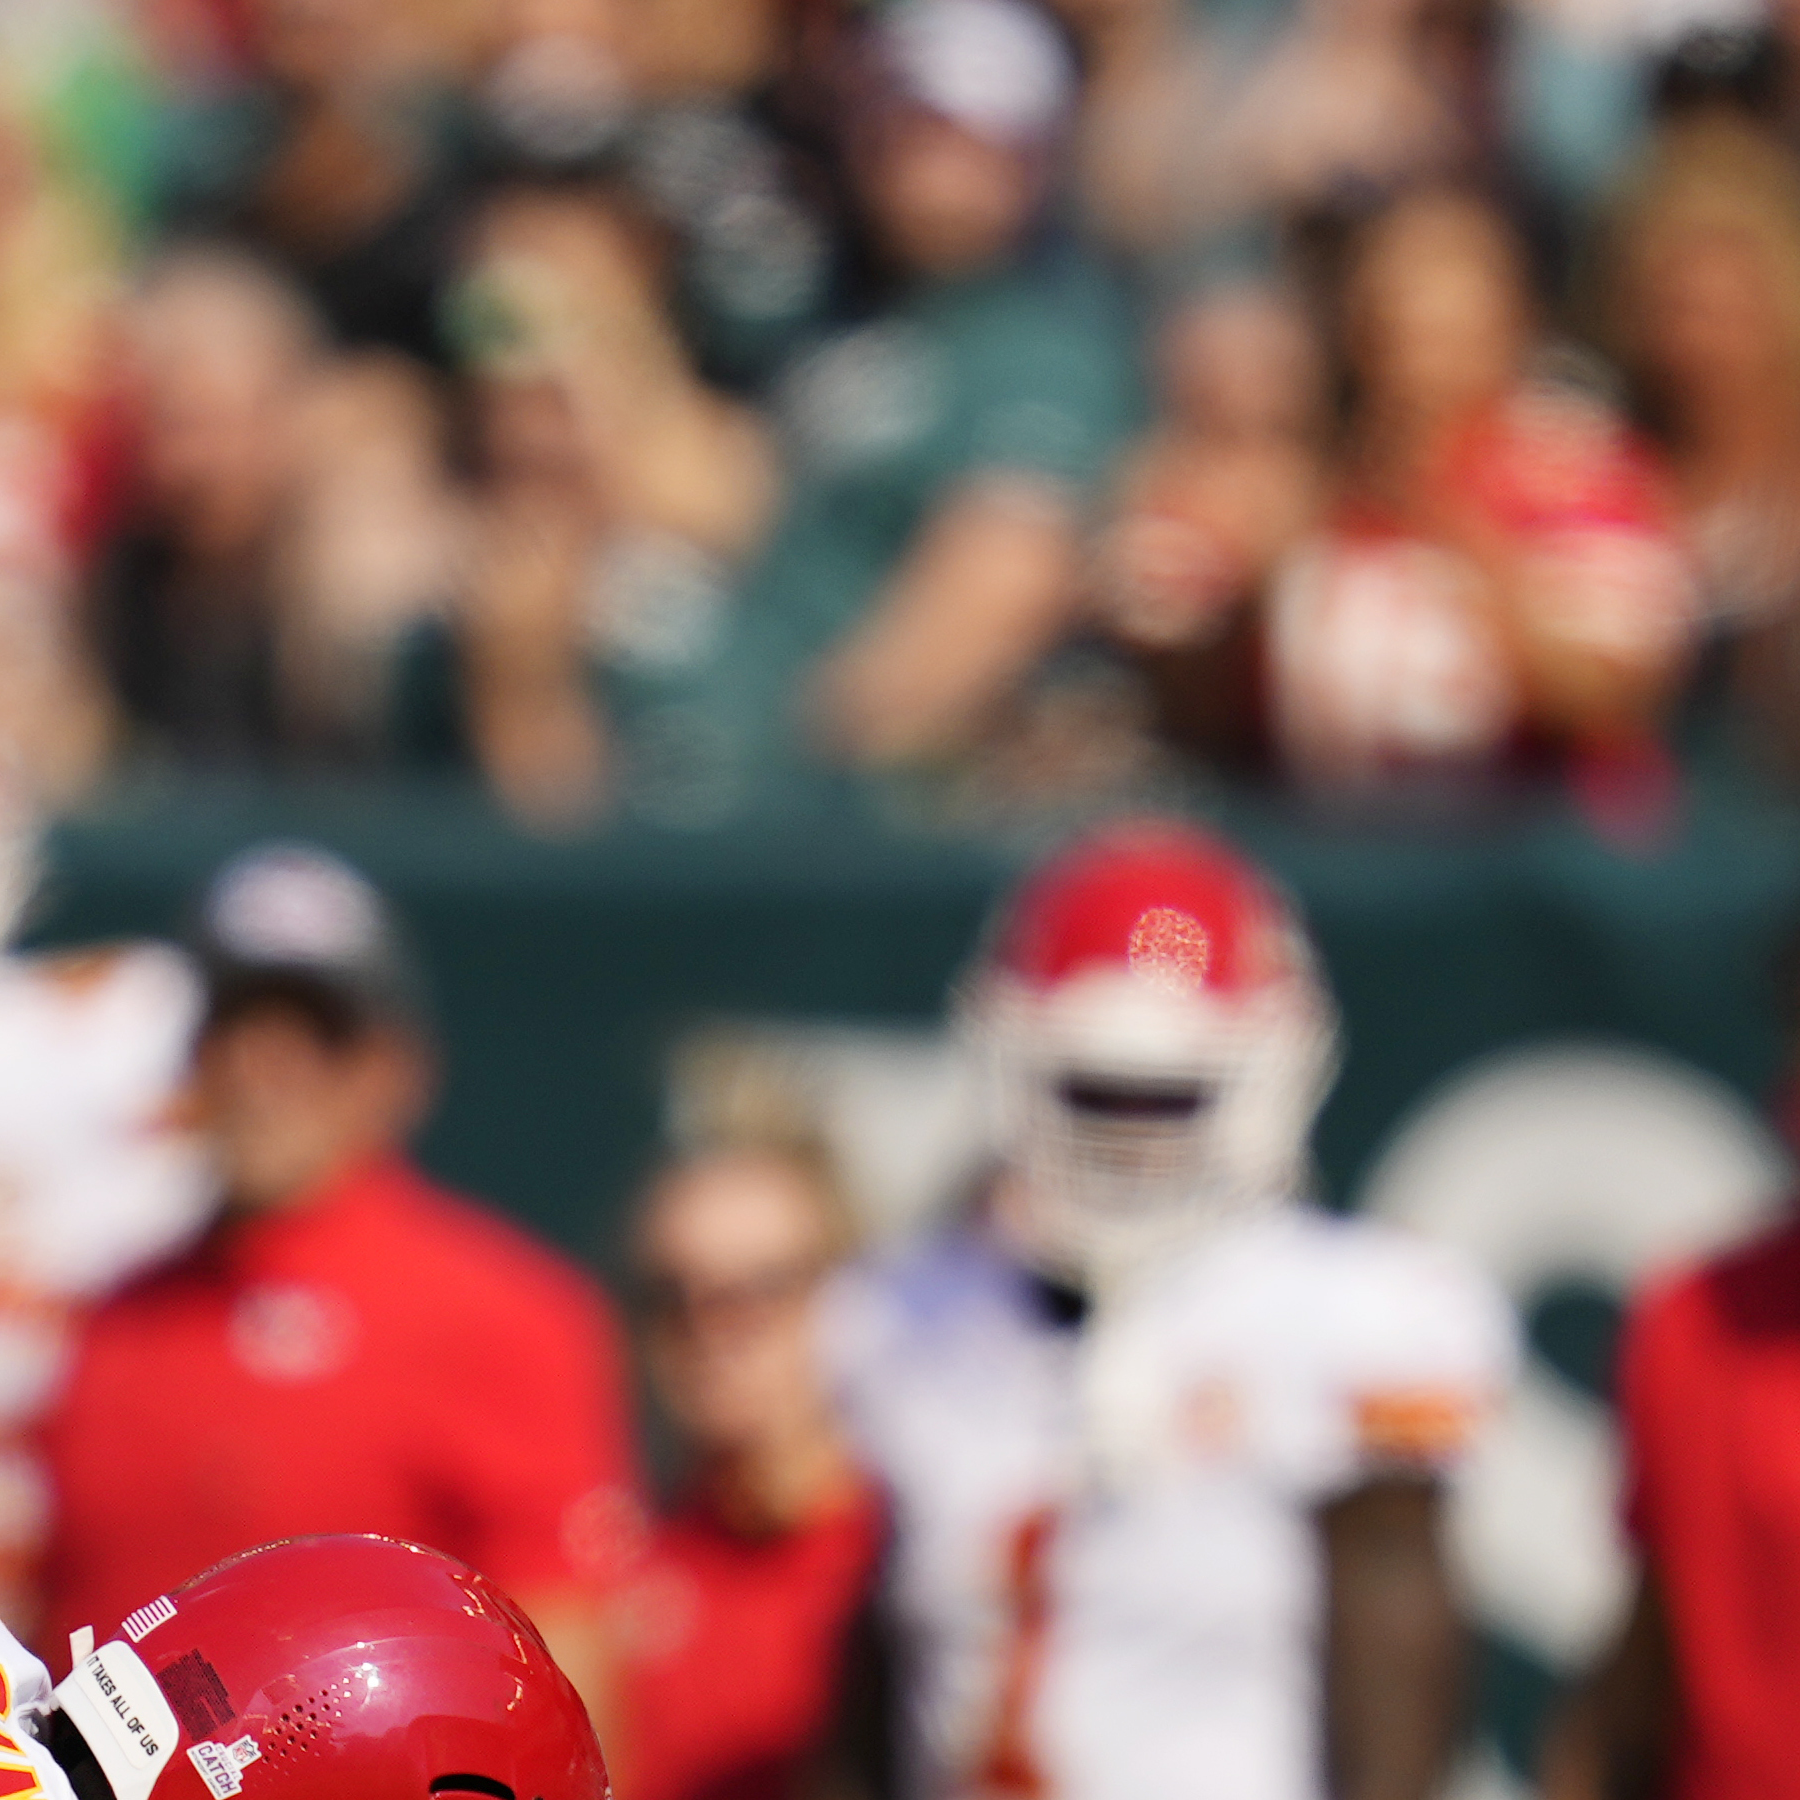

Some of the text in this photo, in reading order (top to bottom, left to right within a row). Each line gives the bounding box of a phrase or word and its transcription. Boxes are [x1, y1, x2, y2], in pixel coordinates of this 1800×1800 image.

[92, 1663, 117, 1697] TAKES
[110, 1695, 130, 1720] ALL
[127, 1717, 145, 1735] OF
[140, 1734, 159, 1757] US
[199, 1745, 238, 1794] CATCH
